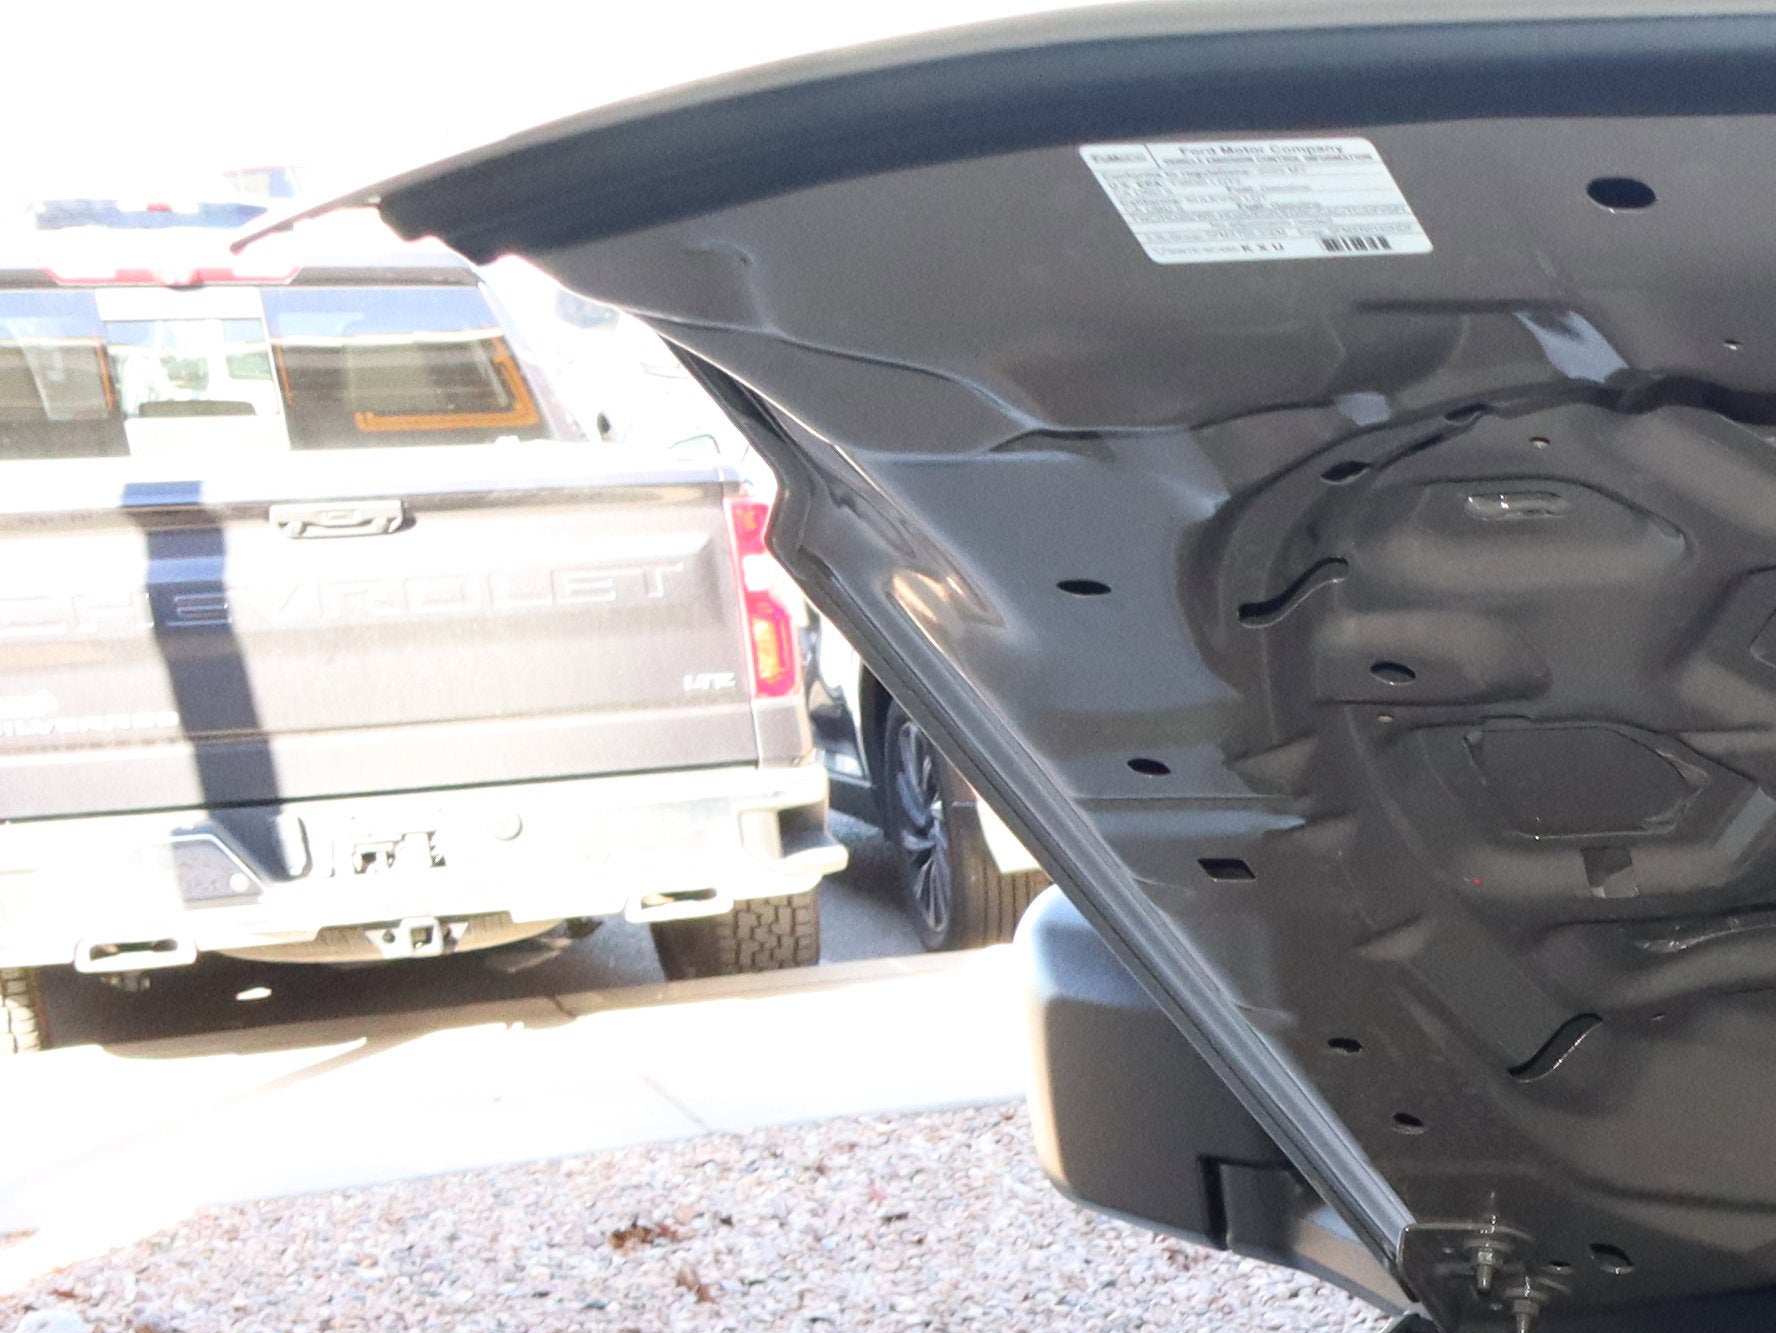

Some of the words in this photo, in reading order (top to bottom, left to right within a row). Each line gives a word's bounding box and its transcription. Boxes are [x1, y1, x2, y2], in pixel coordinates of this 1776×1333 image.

[1179, 146, 1218, 156] Ford
[1220, 145, 1264, 155] Motor
[1268, 143, 1343, 156] Company
